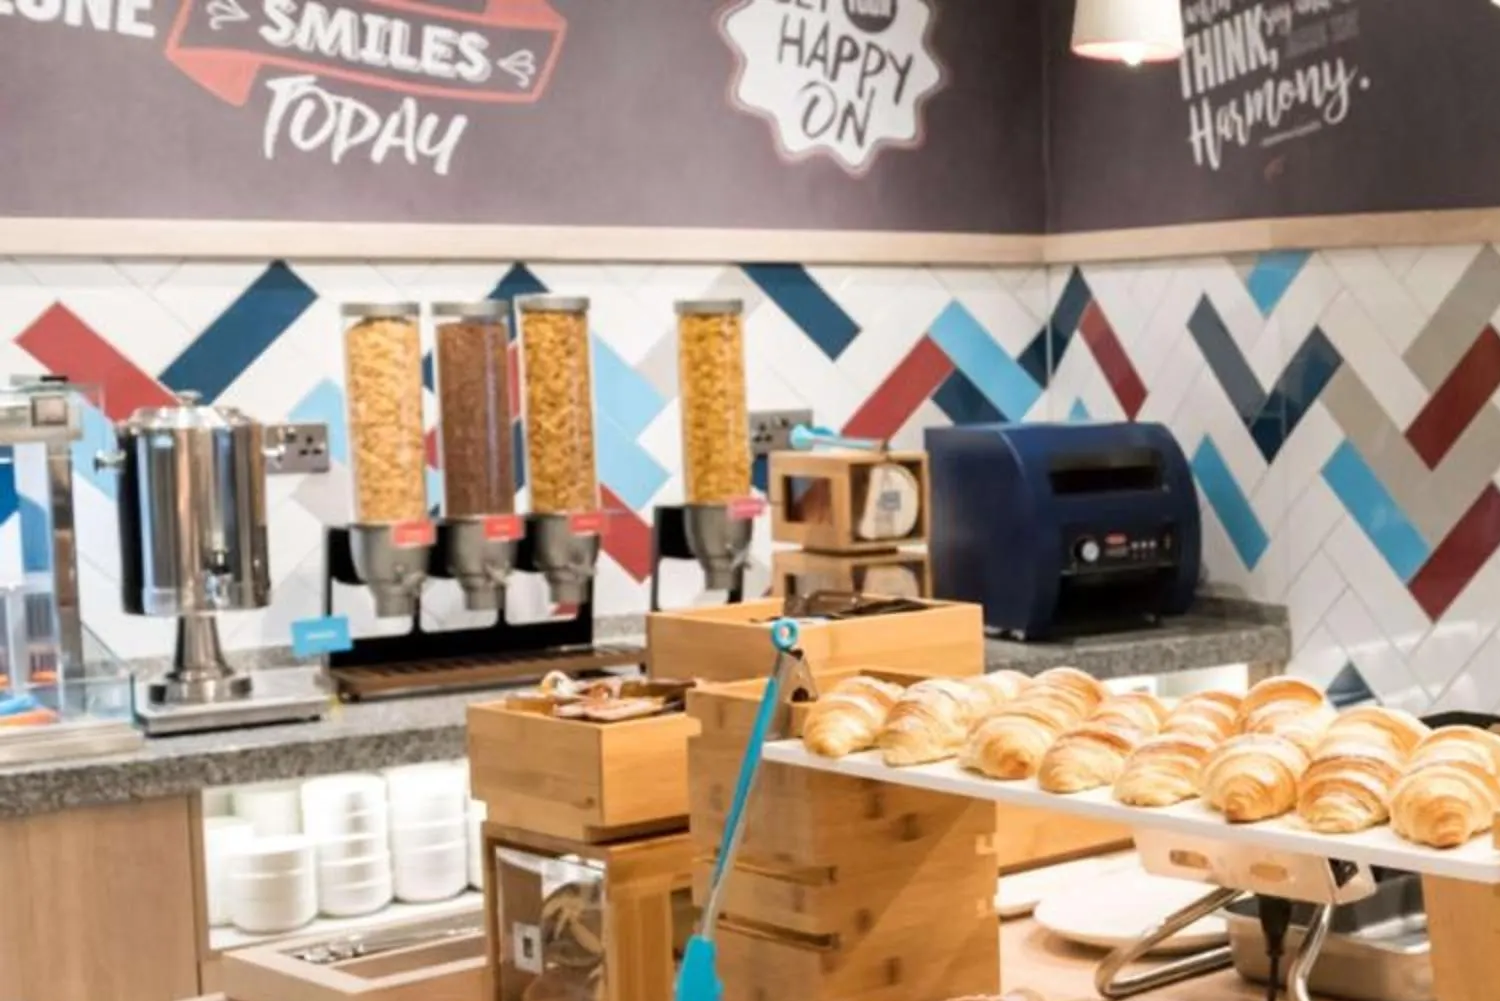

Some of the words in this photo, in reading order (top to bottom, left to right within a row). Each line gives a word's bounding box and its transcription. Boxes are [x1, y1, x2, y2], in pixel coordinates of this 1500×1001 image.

[258, 0, 493, 83] SMILES
[777, 13, 914, 105] HAPPY
[1180, 5, 1278, 99] THINK,
[264, 75, 468, 176] TODAY
[800, 80, 875, 147] ON
[1189, 57, 1370, 170] Harmony.
